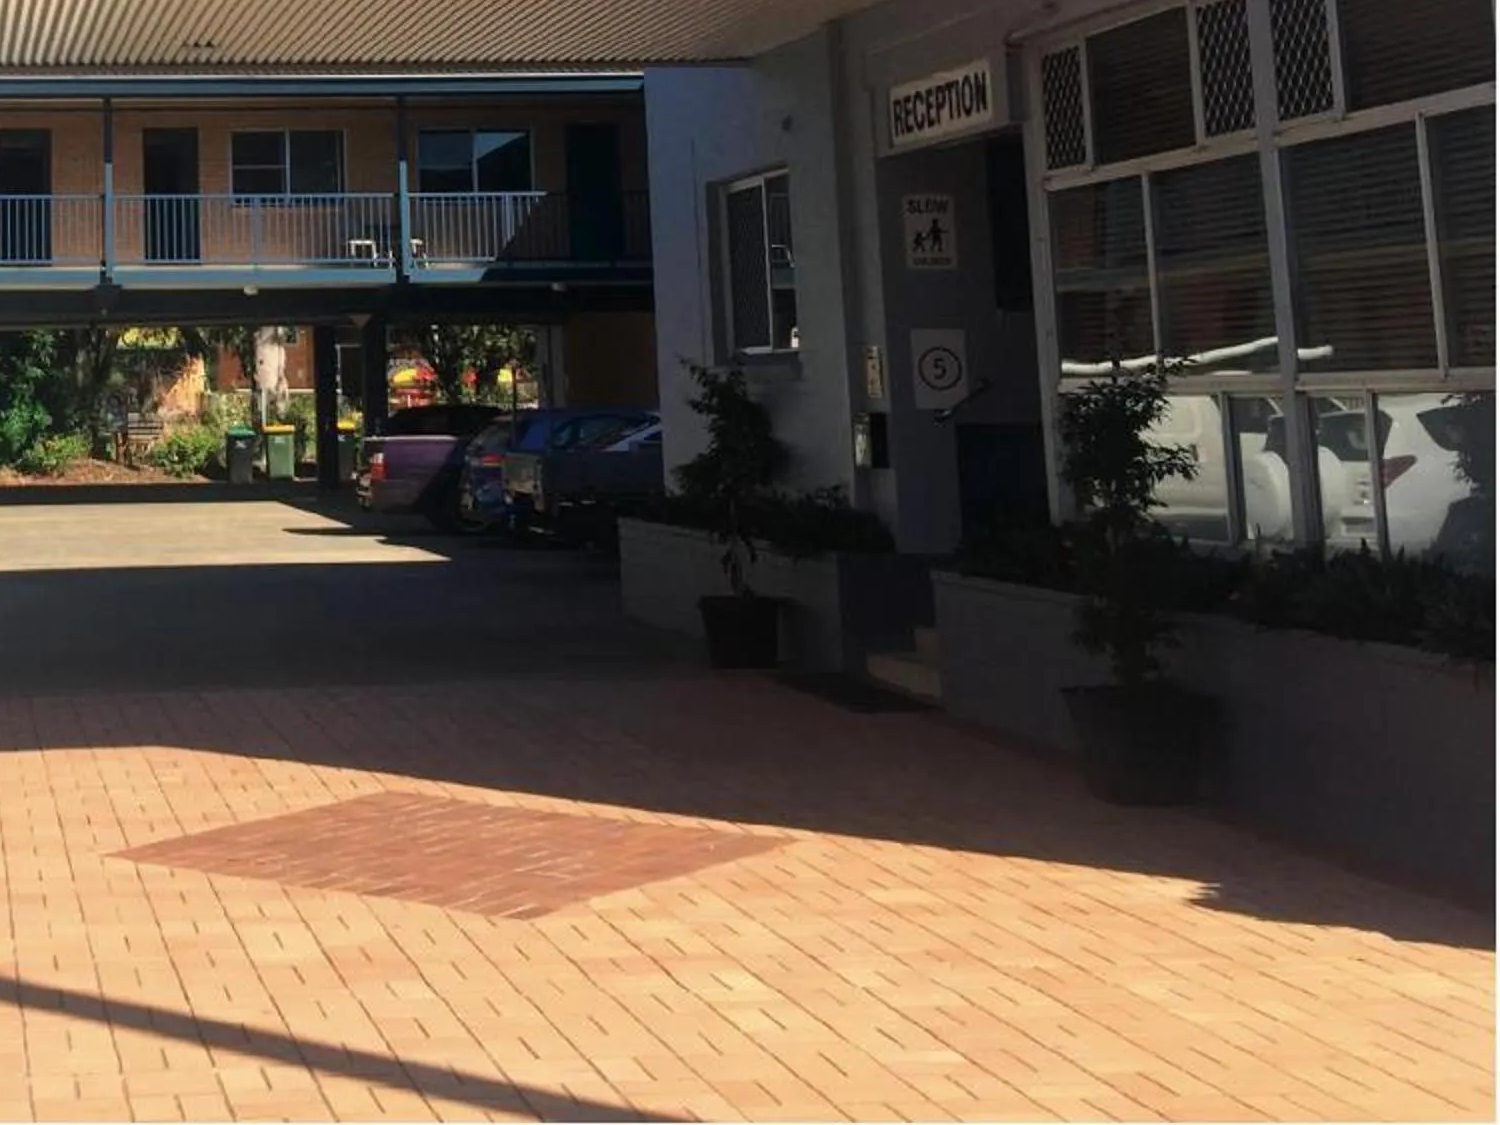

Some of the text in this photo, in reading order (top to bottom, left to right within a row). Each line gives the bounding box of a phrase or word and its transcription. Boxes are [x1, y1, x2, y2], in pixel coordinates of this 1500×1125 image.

[892, 70, 988, 137] RECEPTION
[907, 199, 949, 213] SLOW
[931, 357, 947, 380] 5
